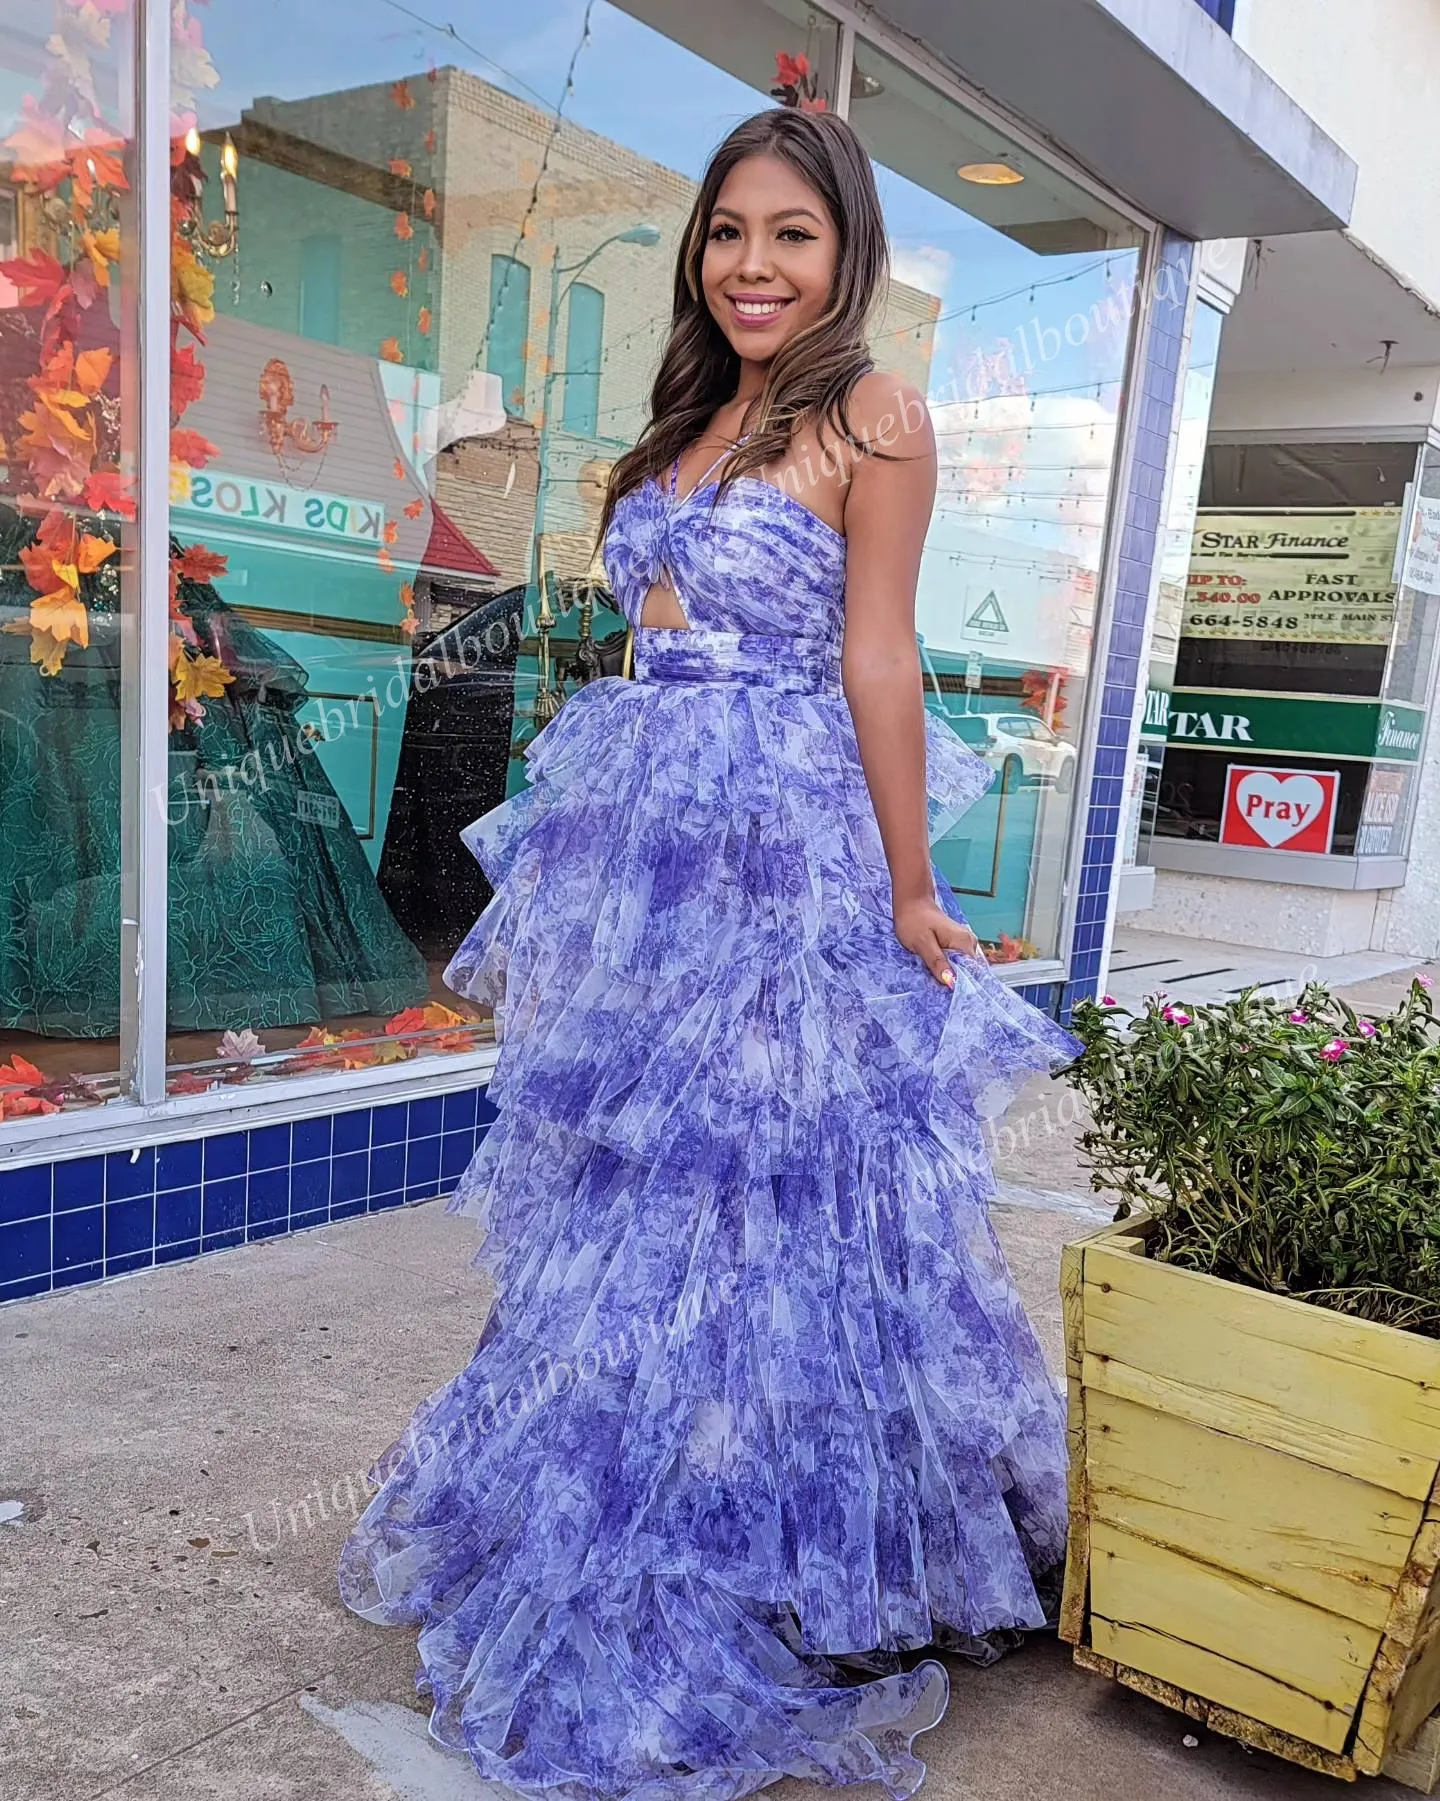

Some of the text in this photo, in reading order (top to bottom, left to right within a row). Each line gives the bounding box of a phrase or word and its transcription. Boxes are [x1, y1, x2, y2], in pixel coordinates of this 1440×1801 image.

[1200, 531, 1349, 550] STAR Finance
[1305, 573, 1358, 586] FAST
[1268, 589, 1396, 604] APPROVALS
[1189, 614, 1298, 630] 664-5848
[1341, 613, 1377, 621] MAIN
[1377, 710, 1420, 750] Finance
[1246, 793, 1311, 828] Pray
